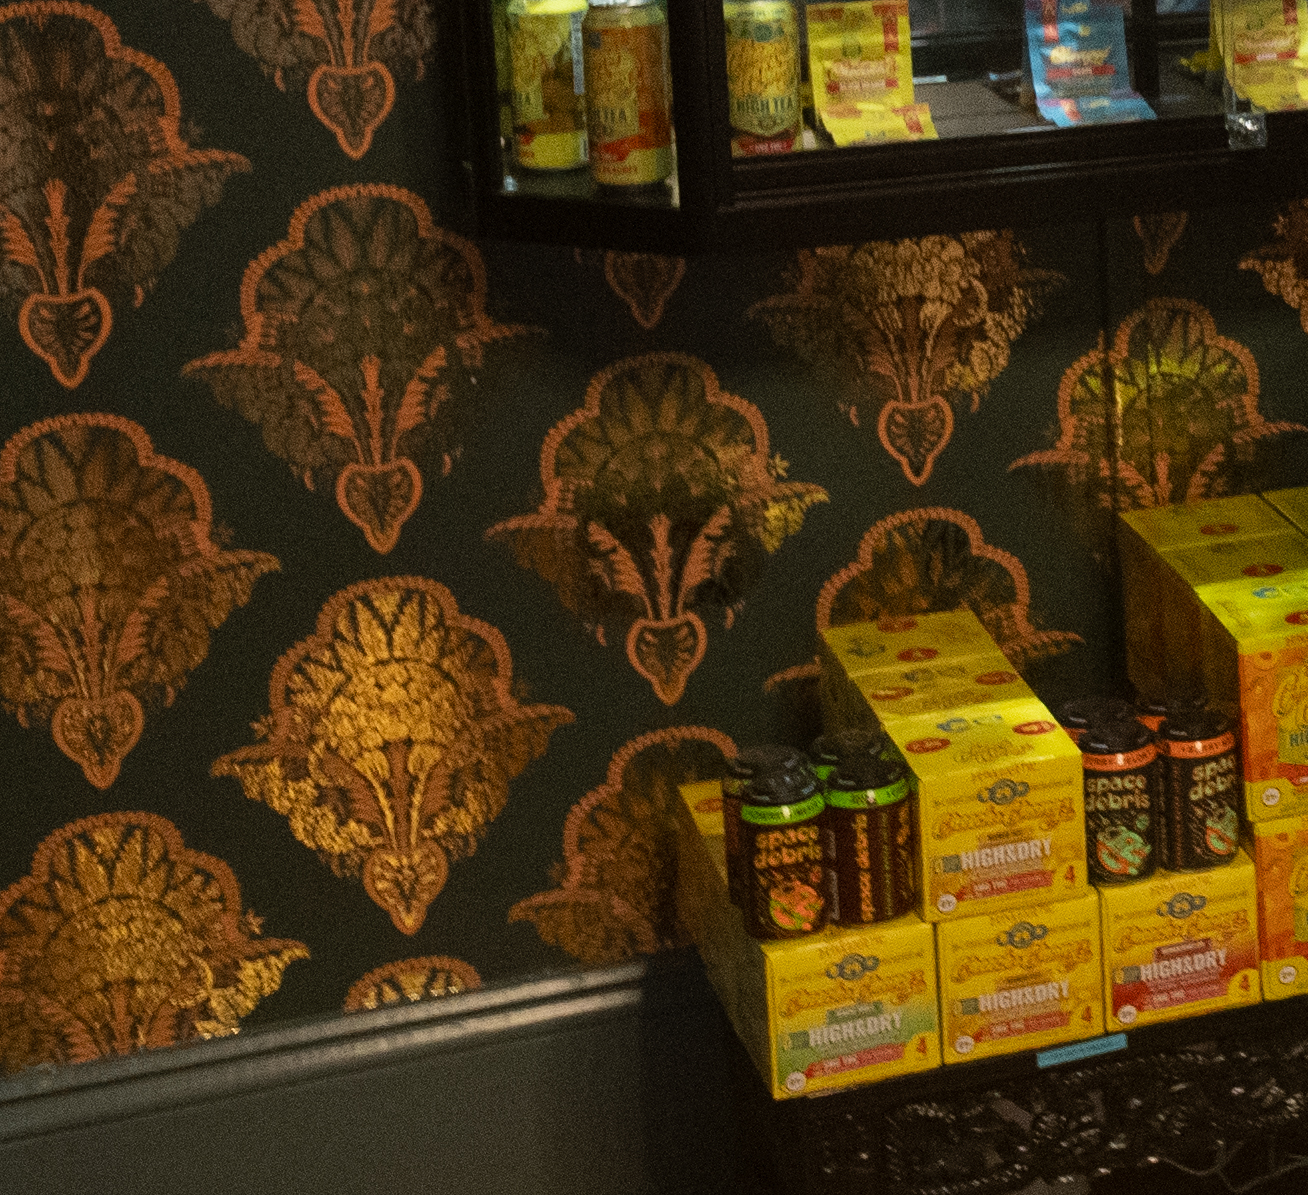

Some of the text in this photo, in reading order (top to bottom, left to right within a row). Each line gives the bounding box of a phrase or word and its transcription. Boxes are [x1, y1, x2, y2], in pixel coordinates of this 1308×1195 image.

[1085, 774, 1148, 794] space
[1085, 788, 1151, 812] debris
[754, 824, 820, 852] space
[752, 841, 824, 871] debris
[961, 837, 1053, 871] HIGH&DRY
[1064, 865, 1075, 883] 4
[1140, 947, 1228, 982] HIGH&DRY
[977, 980, 1072, 1014] HIGH&DRY
[808, 1009, 903, 1047] HIGH&DRY
[1081, 1006, 1093, 1024] 4
[917, 1037, 928, 1055] 4
